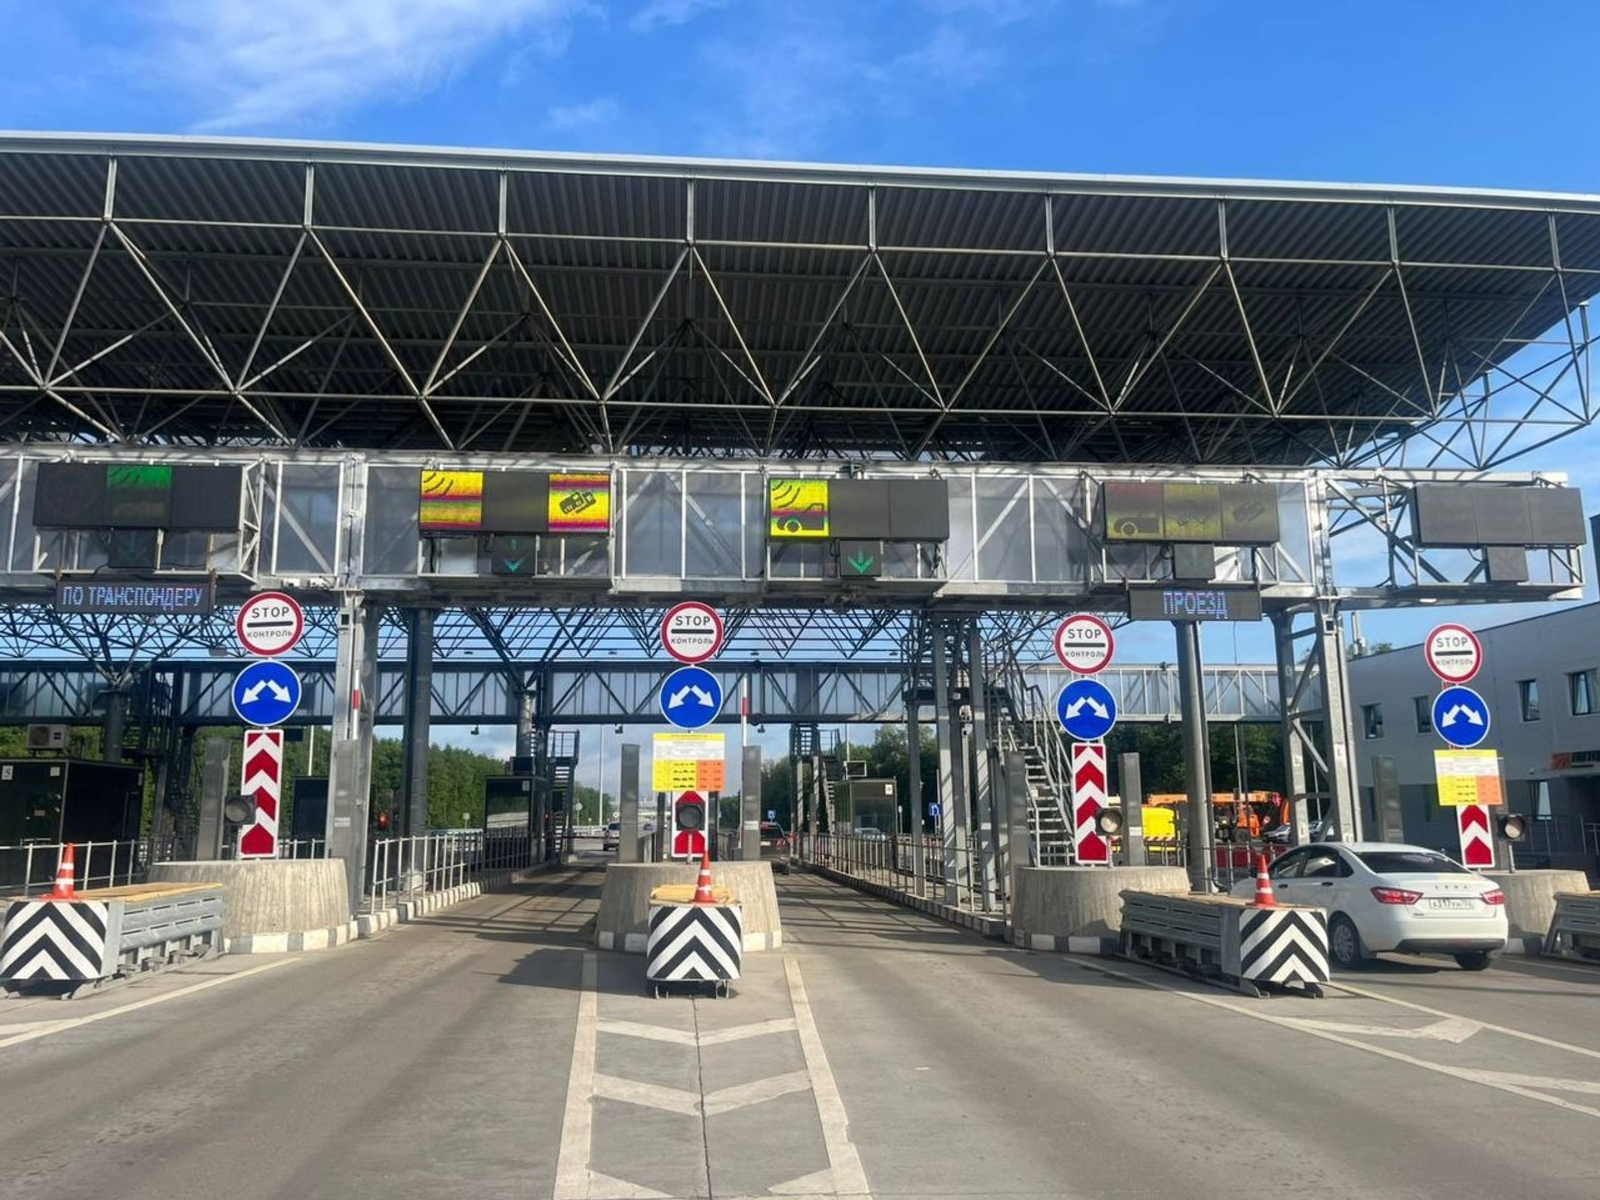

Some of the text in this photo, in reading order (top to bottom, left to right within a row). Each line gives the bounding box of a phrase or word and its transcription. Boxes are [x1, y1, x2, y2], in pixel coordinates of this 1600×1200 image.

[62, 586, 203, 611] ПО ТРАНСПОНДЕРУ
[1163, 591, 1228, 619] ПРОЕЗД
[251, 606, 290, 618] STOP
[675, 615, 711, 626] STOP
[247, 630, 293, 638] КОНТРОЛЬ
[1067, 628, 1101, 639] STOP
[671, 637, 714, 645] КОНТРОЛЬ
[1436, 636, 1468, 648] STOP
